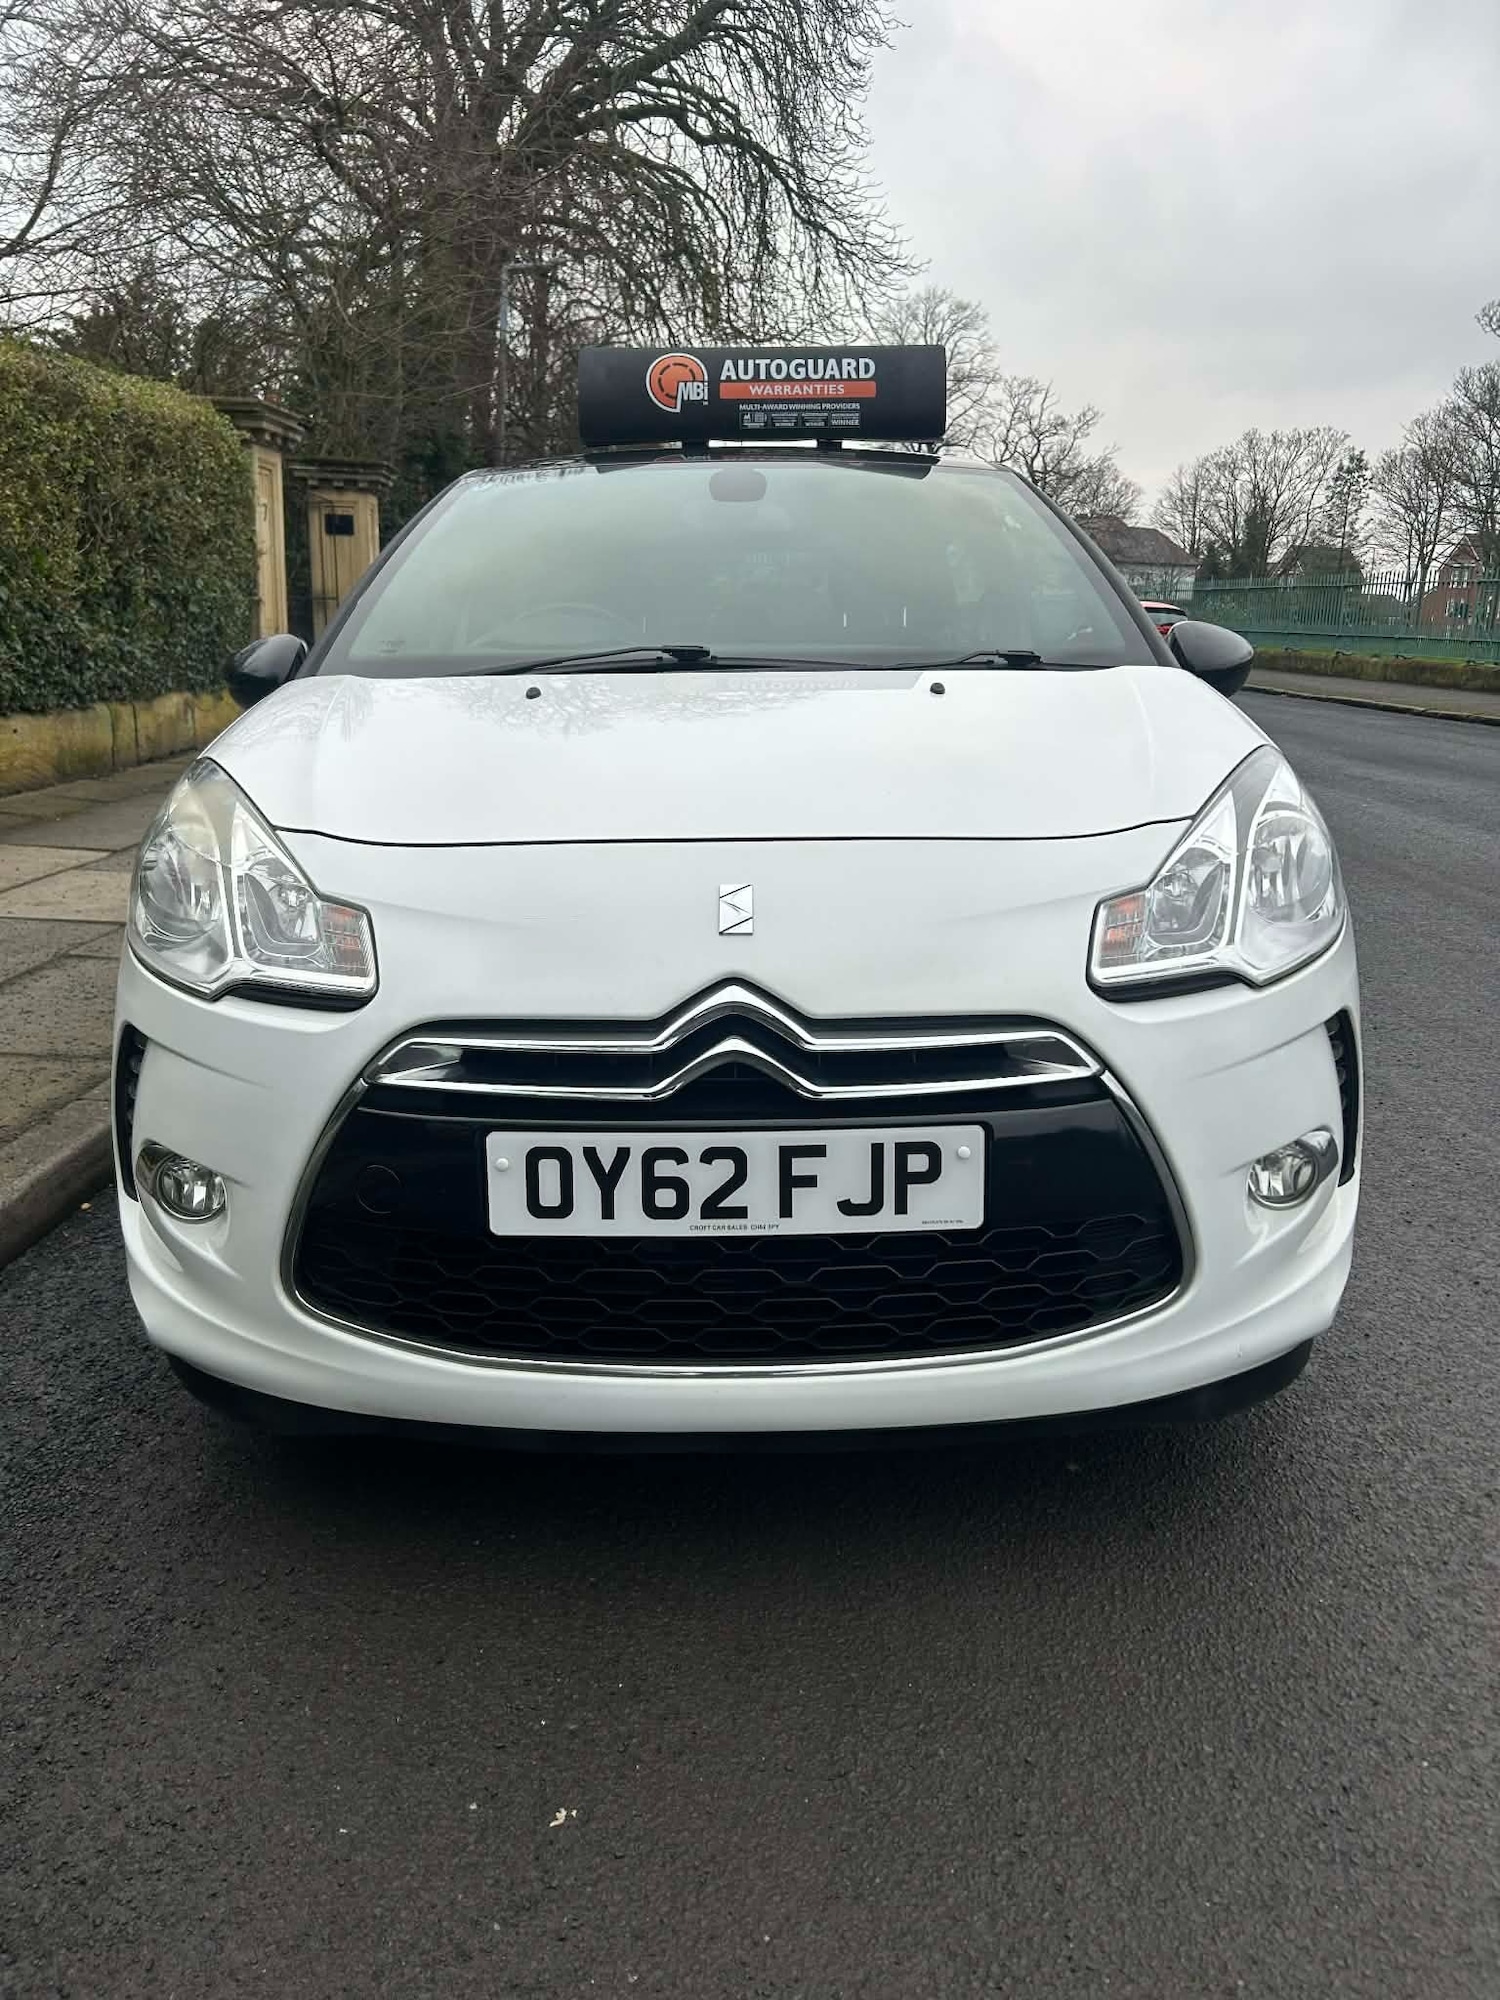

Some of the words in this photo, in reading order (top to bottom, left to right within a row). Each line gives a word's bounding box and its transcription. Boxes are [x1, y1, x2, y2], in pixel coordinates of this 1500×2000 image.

[721, 358, 876, 380] AUTOGUARD
[749, 384, 845, 396] WARRANTIES
[739, 403, 788, 411] MULTI-AWARD
[525, 1146, 748, 1220] OY62
[778, 1141, 942, 1219] FJP
